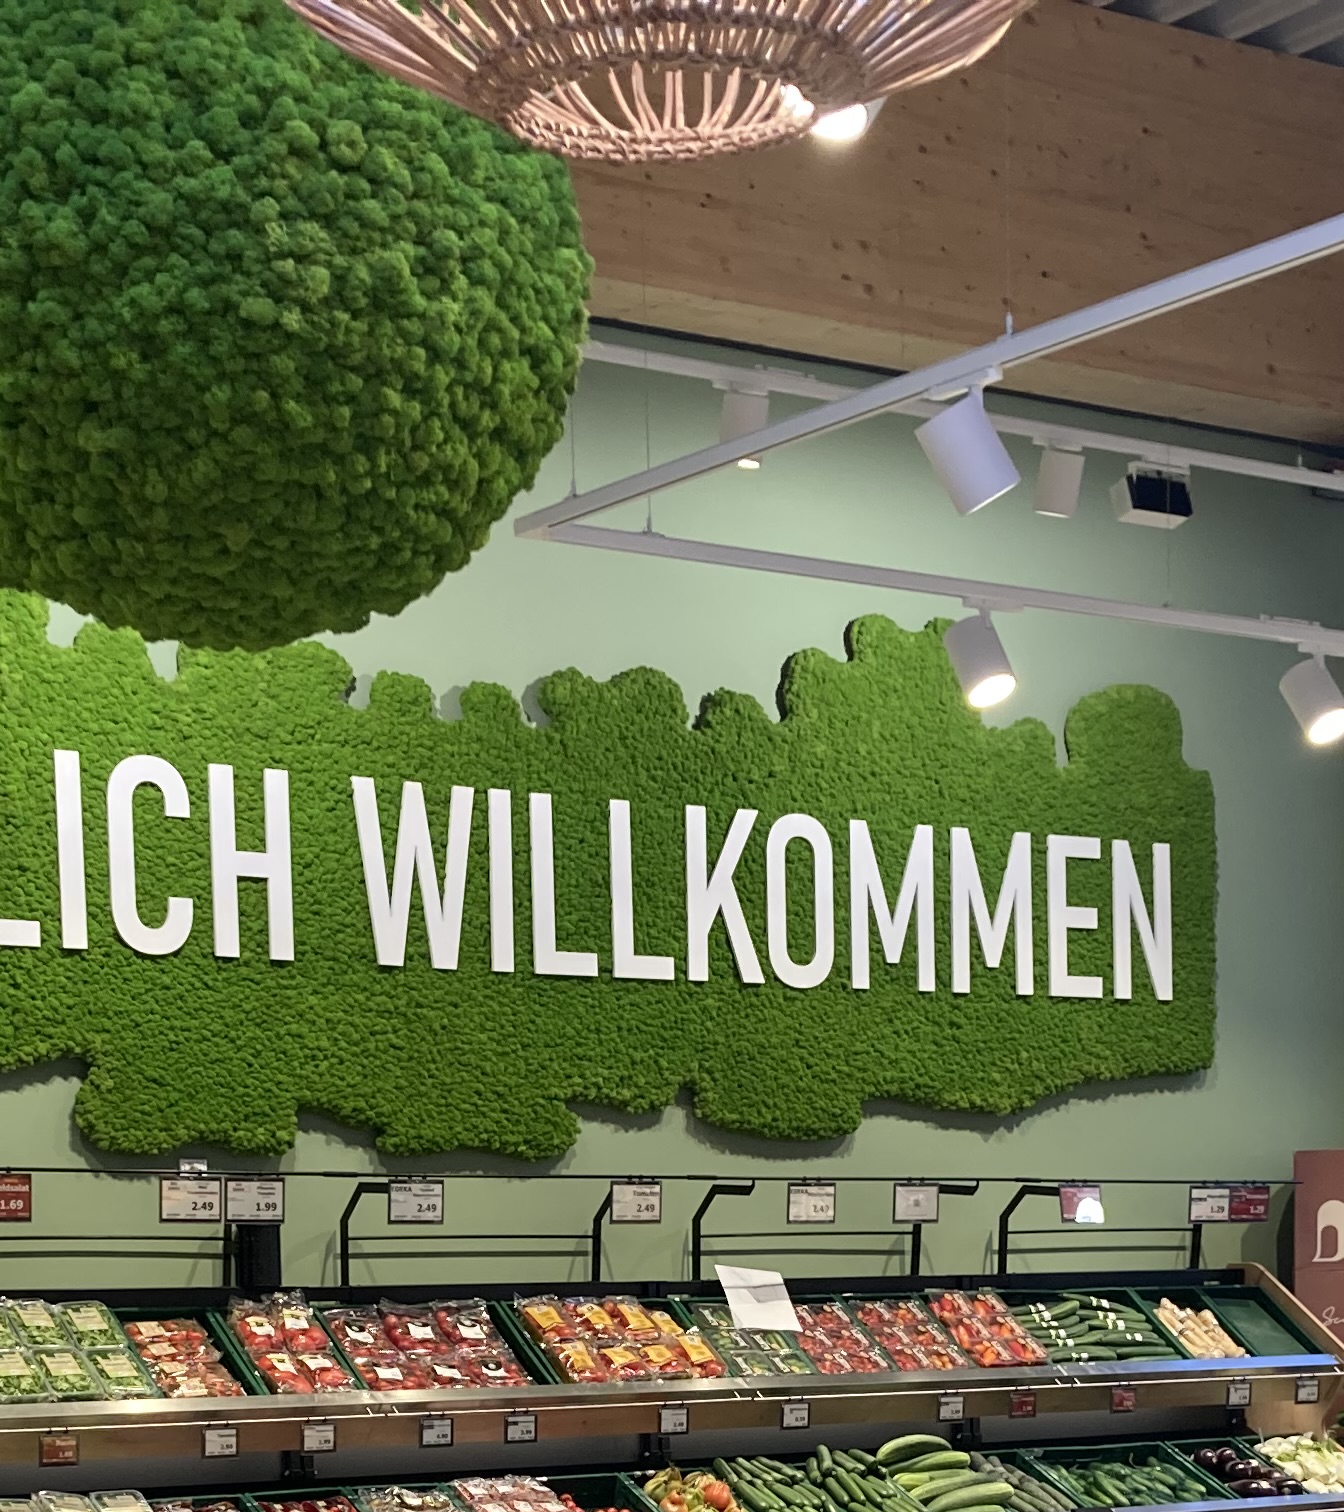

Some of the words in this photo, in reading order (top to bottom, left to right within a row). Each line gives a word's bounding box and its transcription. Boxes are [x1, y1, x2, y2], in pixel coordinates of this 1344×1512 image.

[349, 776, 1174, 1001] WILLKOMMEN
[0, 1199, 24, 1210] 1.69
[191, 1201, 214, 1211] 2.49
[255, 1202, 277, 1212] 1.99
[417, 1203, 437, 1213] 2.49
[636, 1203, 656, 1213] 2.49
